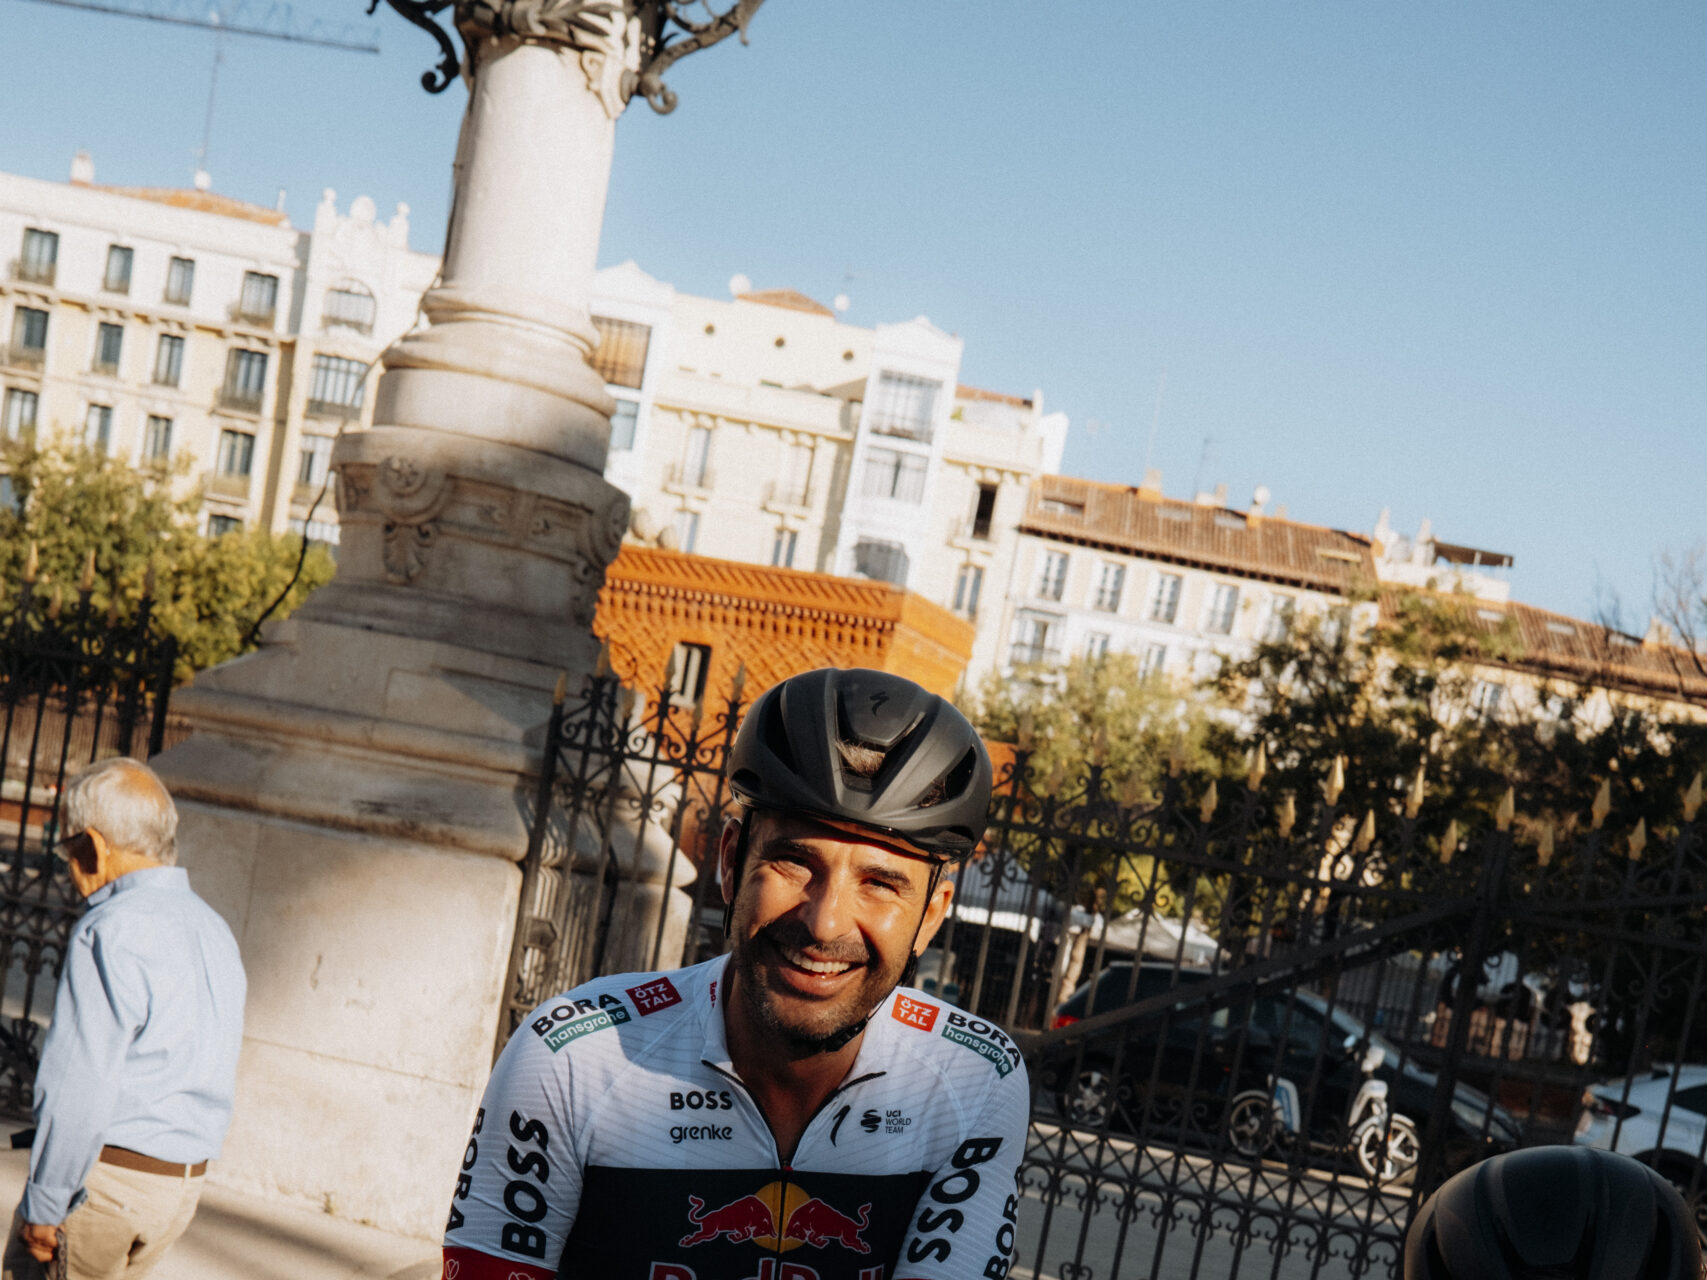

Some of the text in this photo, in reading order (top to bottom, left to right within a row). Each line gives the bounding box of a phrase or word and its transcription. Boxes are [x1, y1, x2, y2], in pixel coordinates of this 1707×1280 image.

[634, 982, 668, 999] ÖTZ
[640, 993, 674, 1010] TAL
[900, 998, 933, 1017] ÖTZ
[531, 993, 622, 1037] BORA
[899, 1008, 928, 1026] TAL
[547, 1010, 626, 1047] hansgrohe
[948, 1012, 1021, 1069] BORA
[945, 1028, 1009, 1073] hansgrohe
[670, 1091, 733, 1110] BOSS
[885, 1118, 912, 1126] WORLD
[886, 1110, 901, 1118] UCI
[670, 1125, 733, 1144] grenke
[885, 1126, 904, 1134] TEAM
[500, 1110, 550, 1259] BOSS
[907, 1137, 1003, 1263] BOSS
